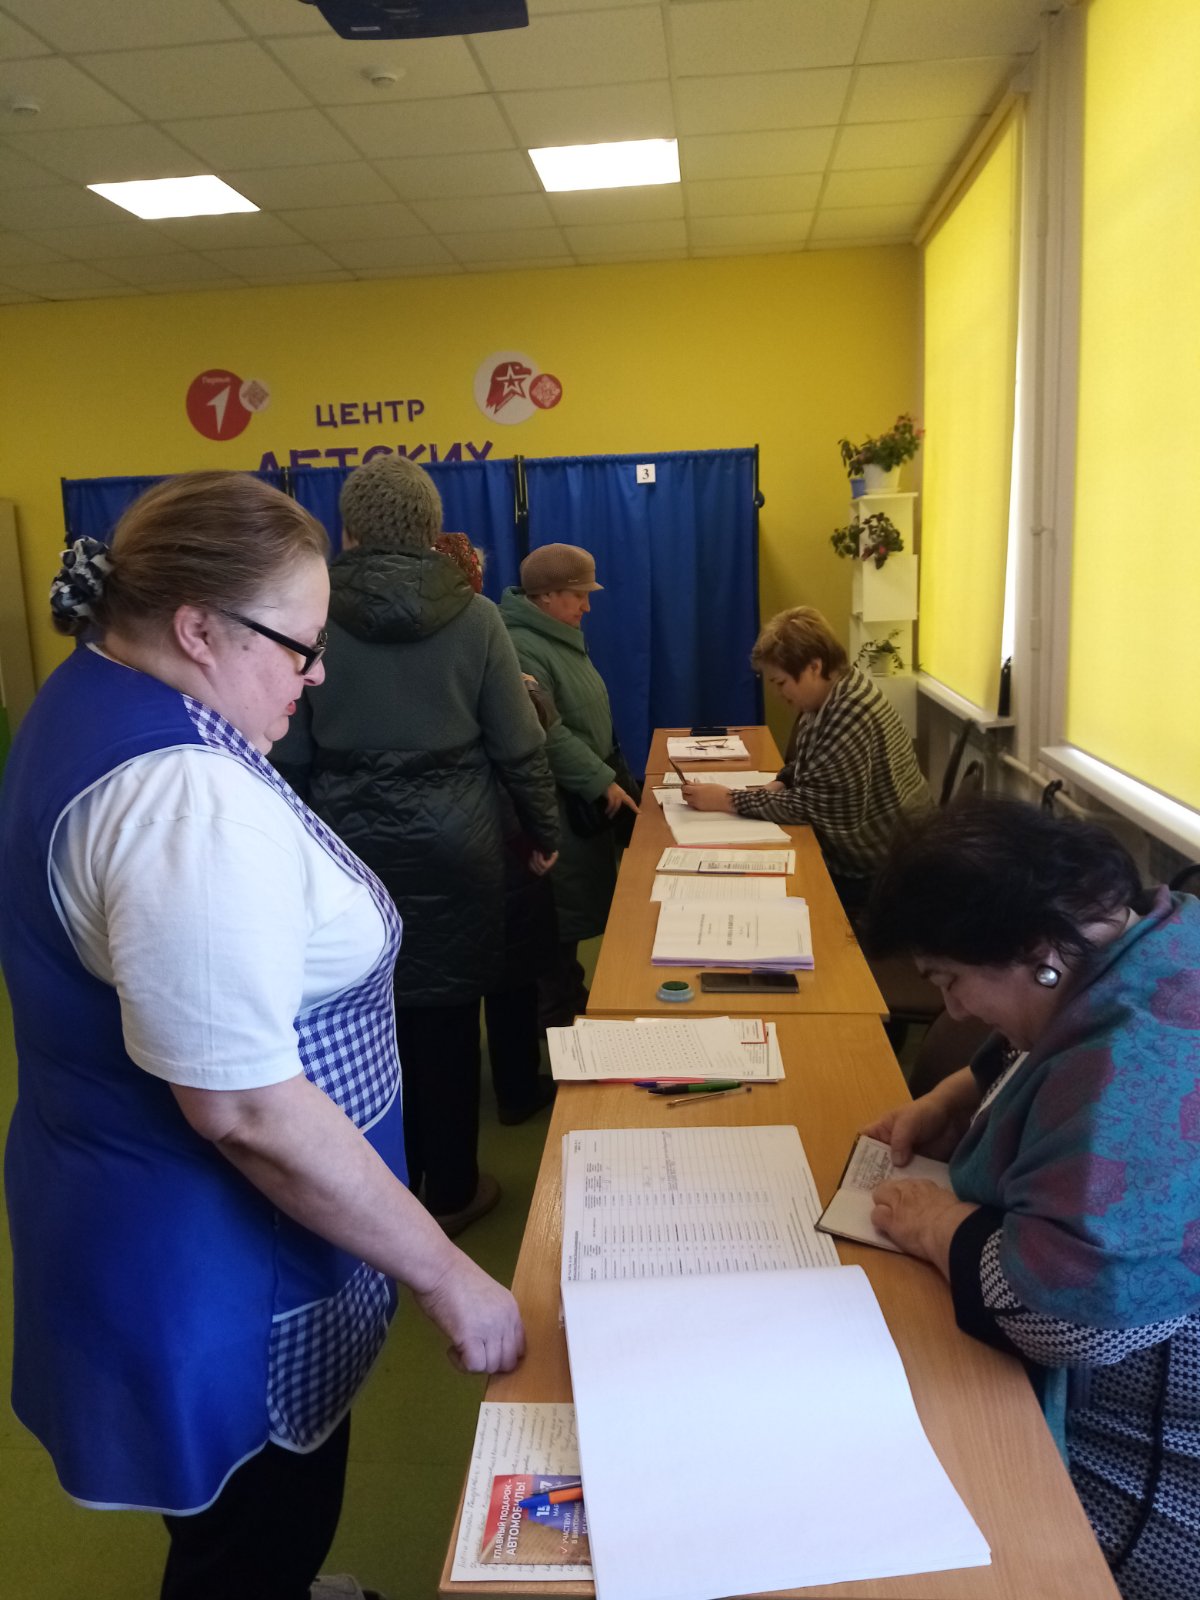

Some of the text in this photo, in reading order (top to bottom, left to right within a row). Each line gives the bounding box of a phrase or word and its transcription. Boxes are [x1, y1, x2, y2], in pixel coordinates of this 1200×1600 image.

[316, 399, 425, 428] ЦЕНТР
[642, 468, 650, 480] 3
[494, 1522, 506, 1559] ГЛАВНЫЙ
[500, 1484, 512, 1522] ПОДАРОК
[562, 1512, 571, 1544] УЧАСТВУЙ
